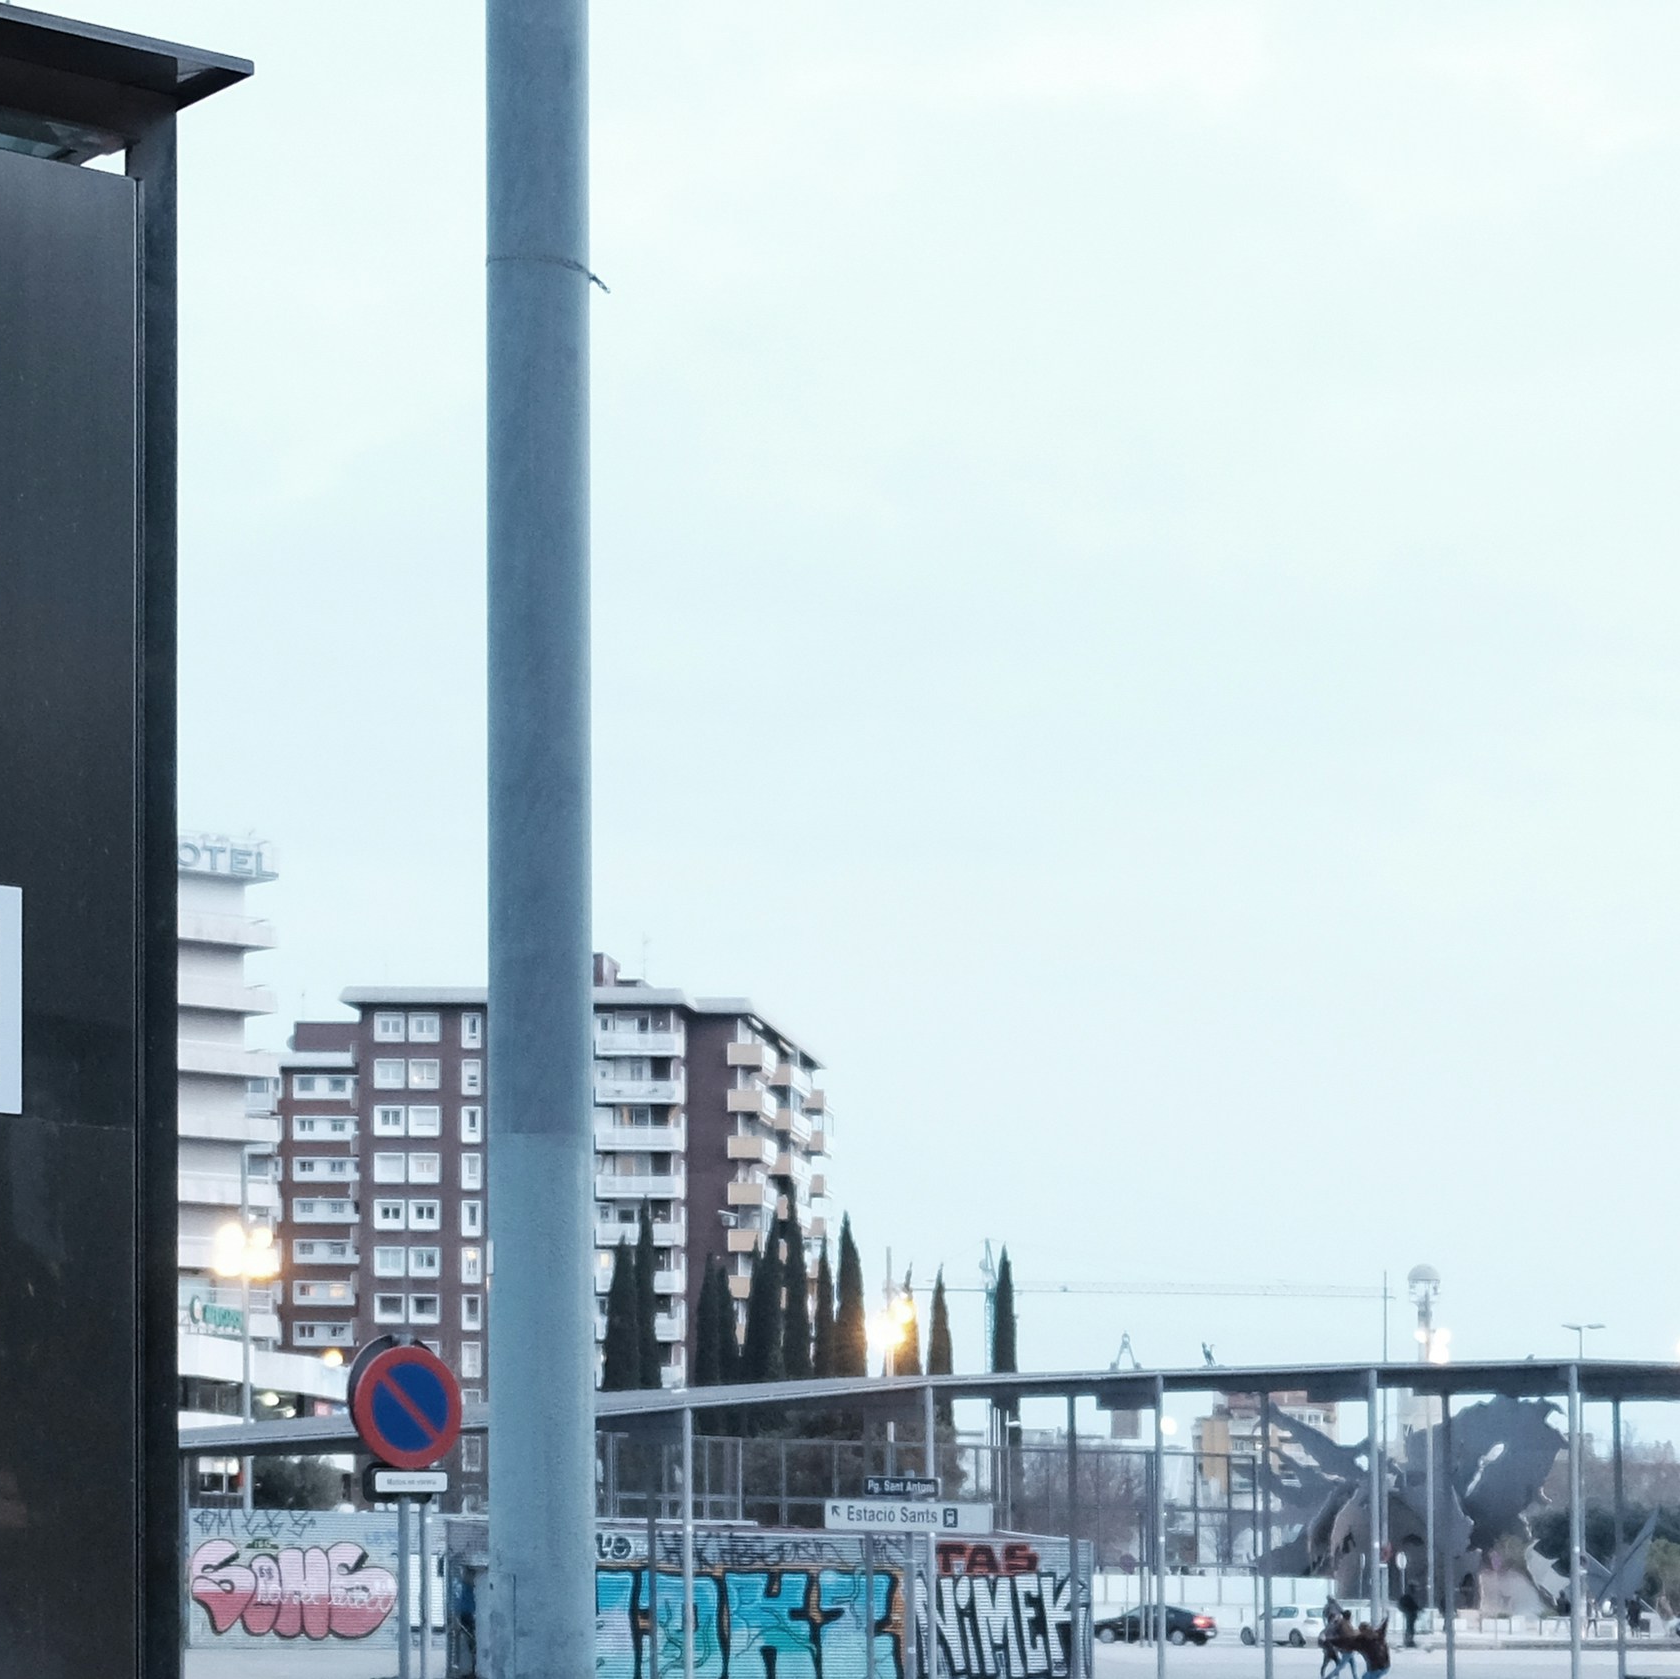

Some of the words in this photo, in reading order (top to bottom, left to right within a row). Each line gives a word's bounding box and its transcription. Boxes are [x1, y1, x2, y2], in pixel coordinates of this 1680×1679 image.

[884, 1480, 903, 1492] Sant
[905, 1481, 935, 1494] Antoni
[847, 1504, 895, 1522] Estació
[900, 1506, 938, 1524] Sants
